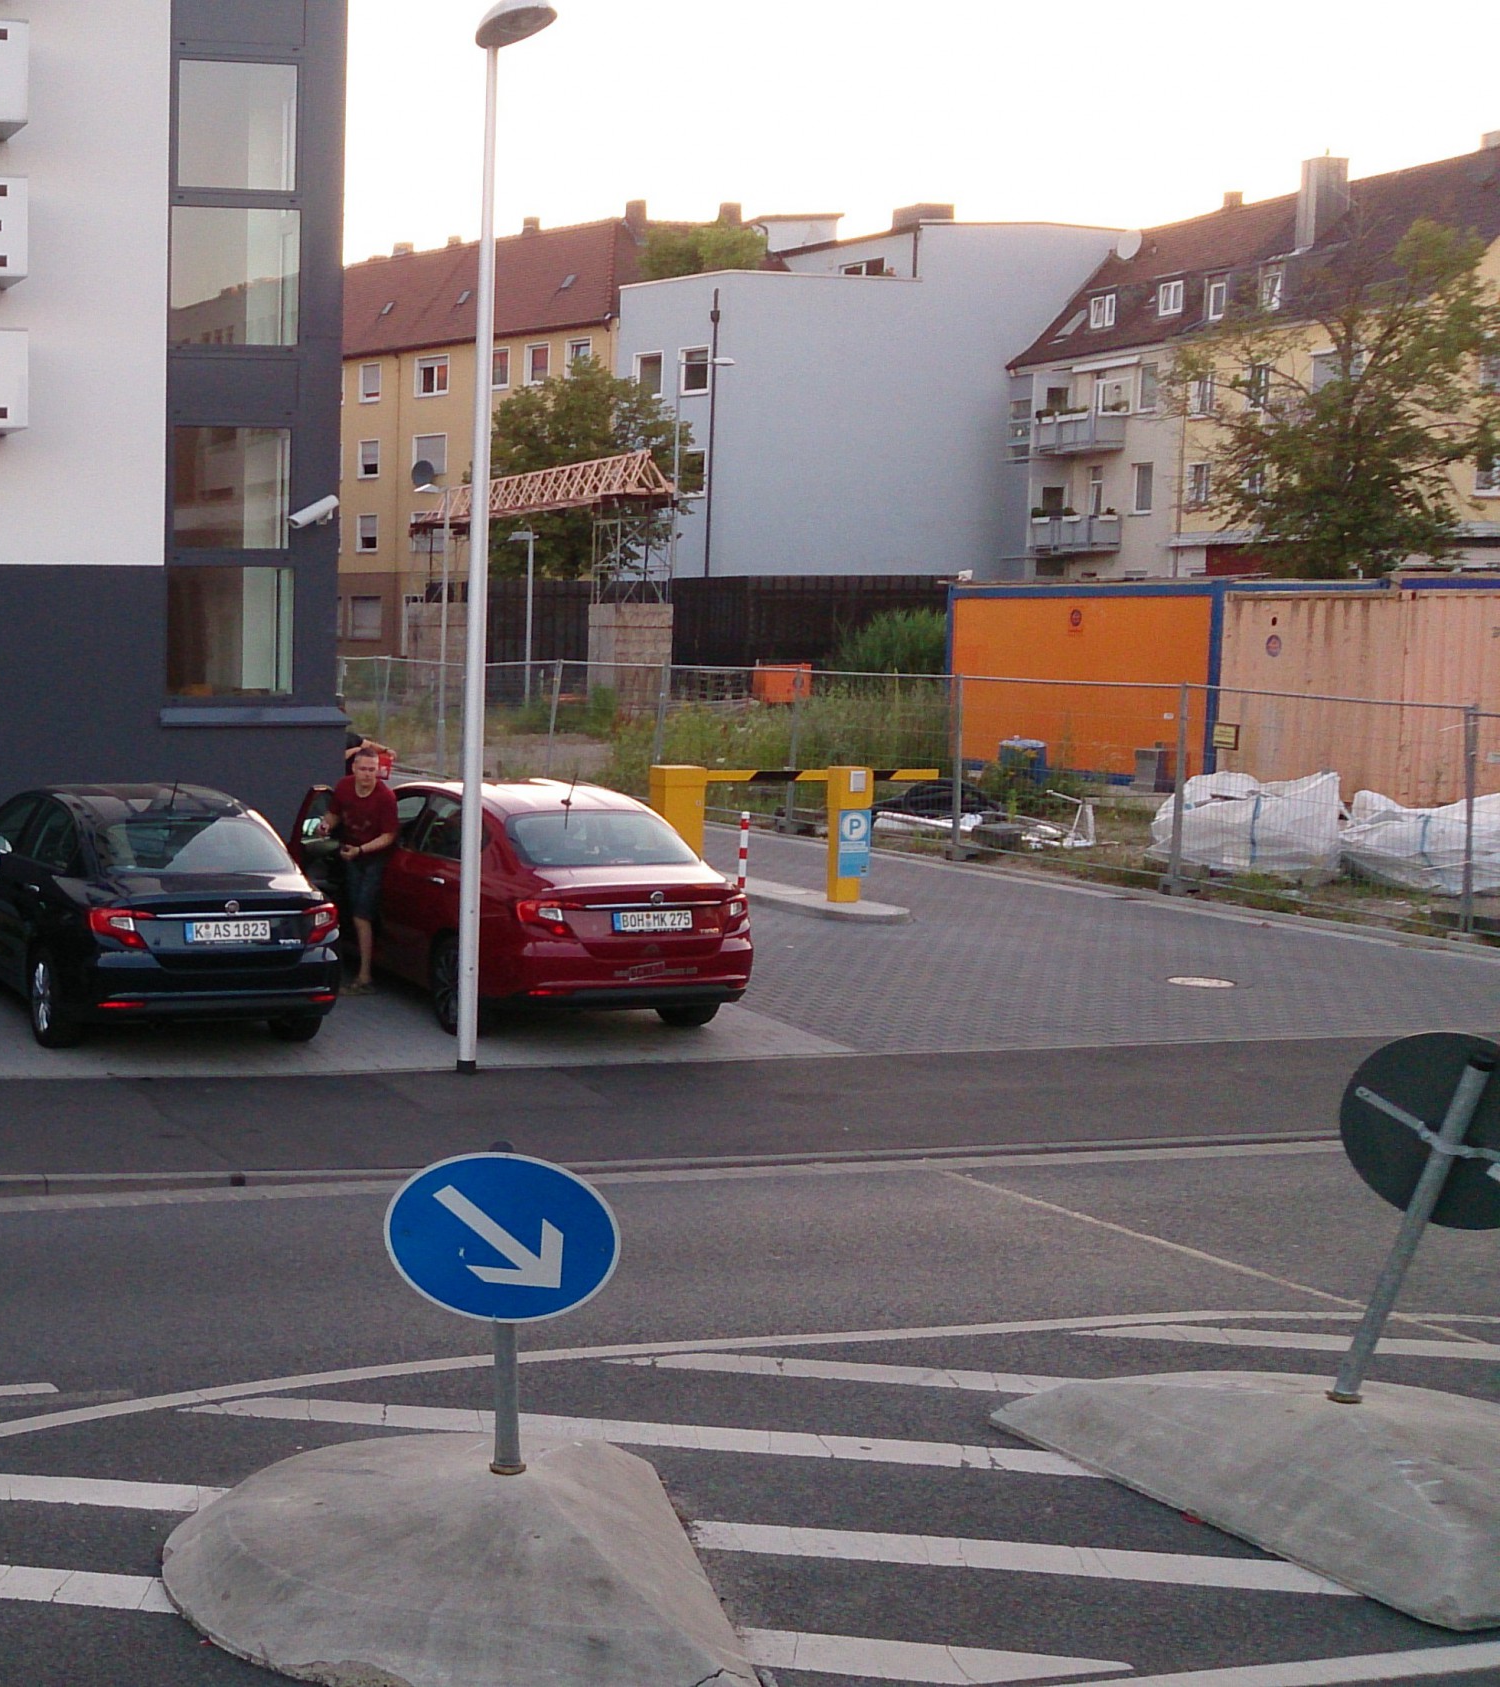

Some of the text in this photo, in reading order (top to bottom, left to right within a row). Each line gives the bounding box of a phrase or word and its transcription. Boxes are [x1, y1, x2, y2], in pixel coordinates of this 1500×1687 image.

[849, 818, 862, 836] P
[622, 912, 691, 928] BOH MK 275
[195, 923, 268, 939] K AS 1823
